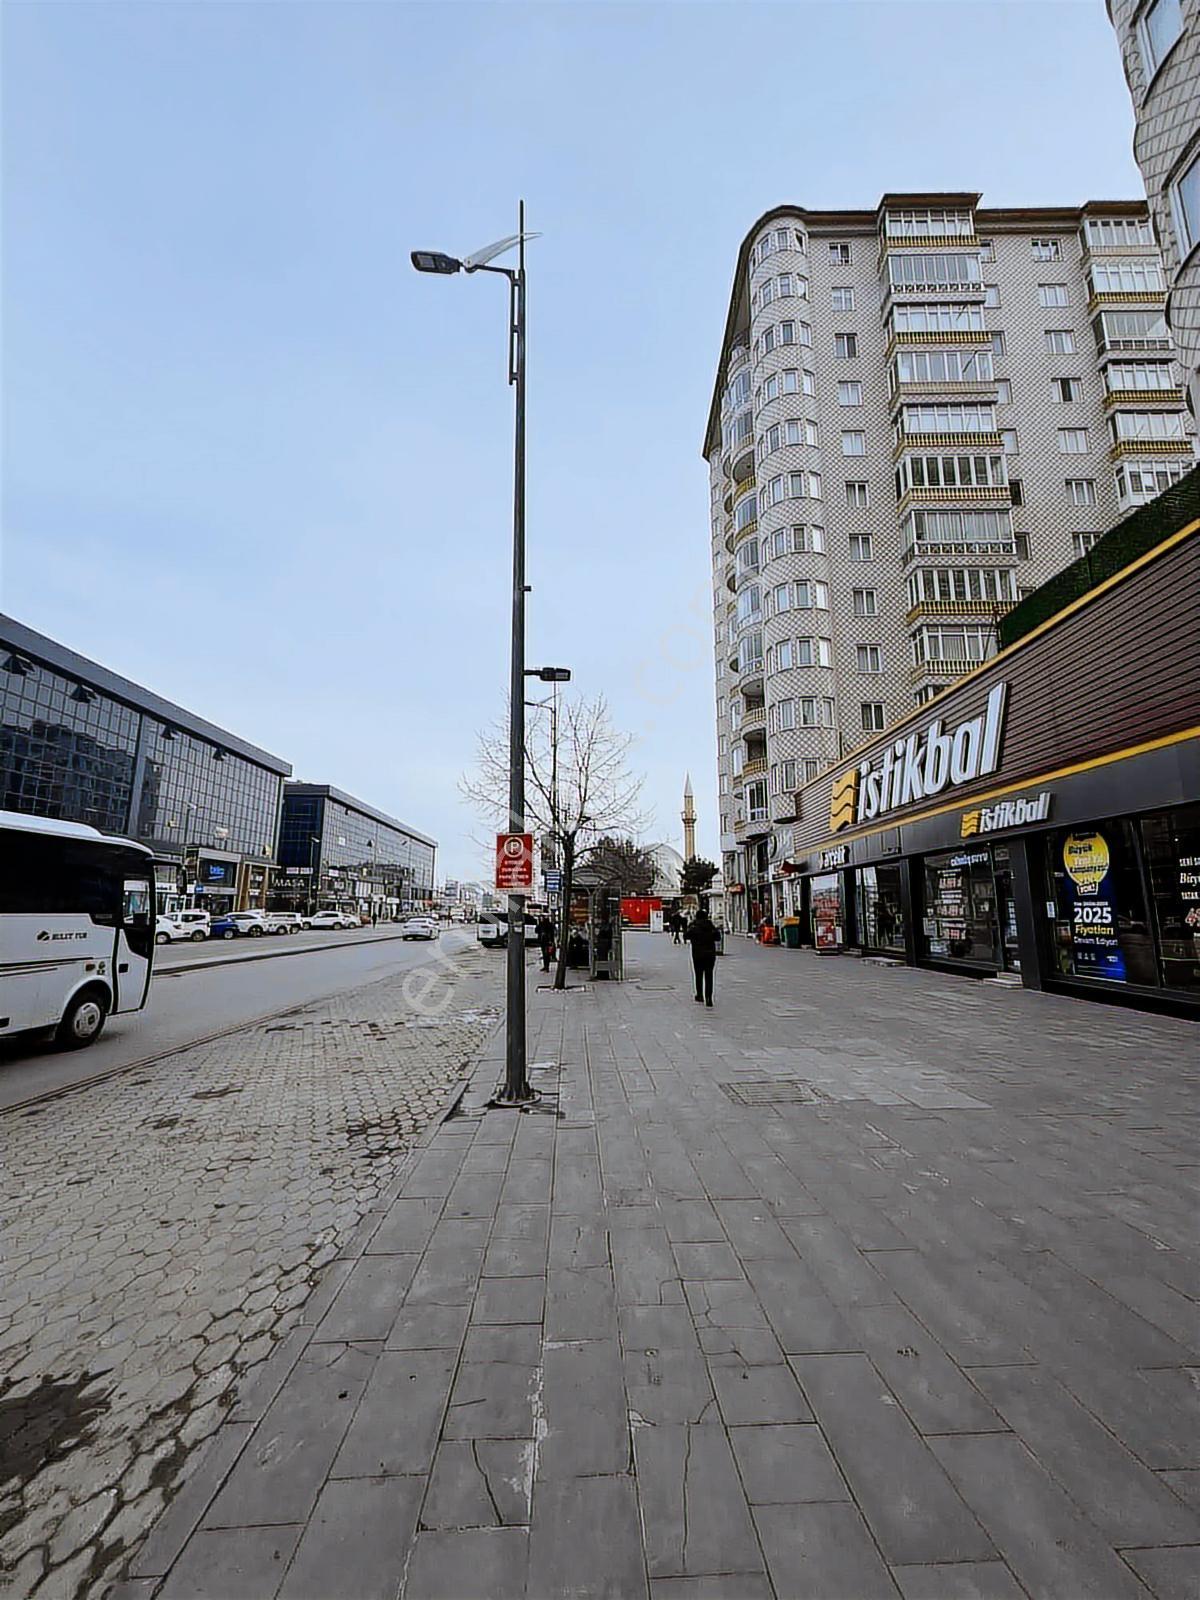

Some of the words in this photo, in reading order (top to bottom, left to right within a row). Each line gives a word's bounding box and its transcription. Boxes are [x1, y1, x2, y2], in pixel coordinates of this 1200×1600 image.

[857, 682, 1006, 824] istikbal
[980, 793, 1051, 833] istikbal
[1073, 906, 1112, 924] 2025
